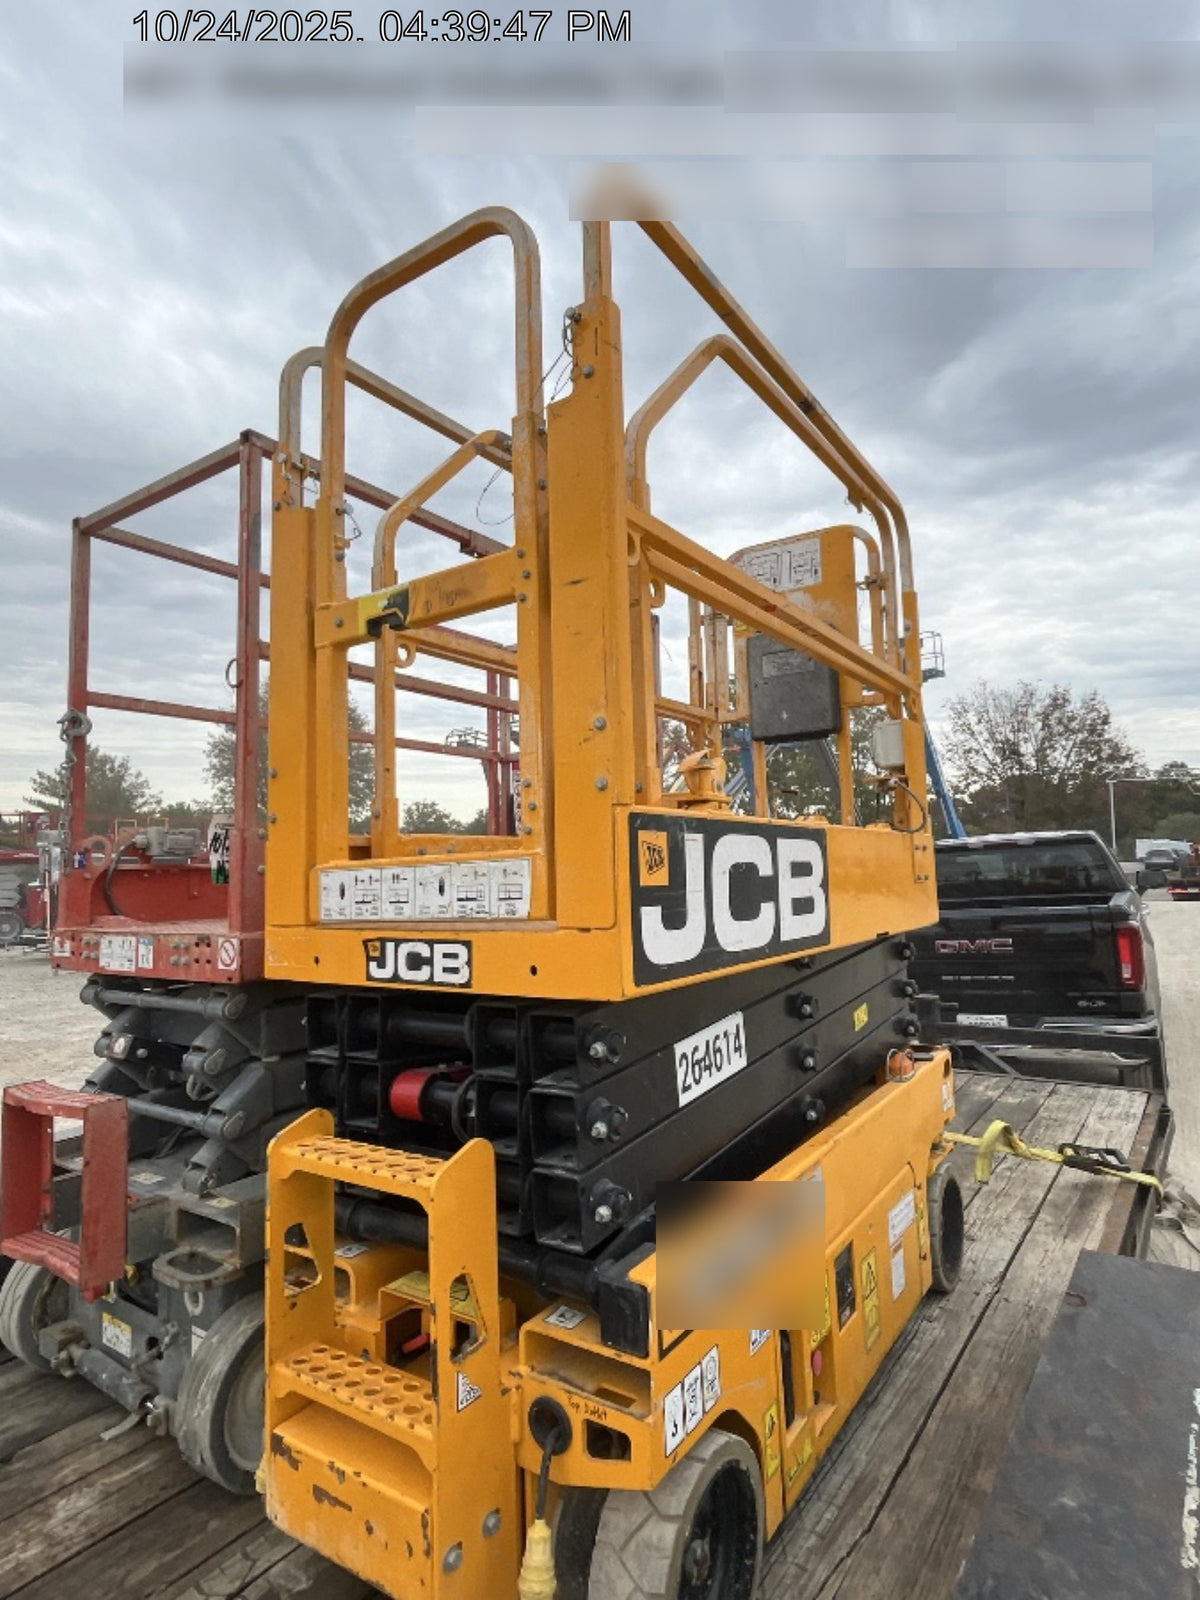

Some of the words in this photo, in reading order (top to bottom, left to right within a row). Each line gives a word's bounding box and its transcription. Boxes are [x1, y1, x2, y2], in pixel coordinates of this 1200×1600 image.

[640, 833, 827, 966] JCB
[368, 941, 470, 984] JCB
[935, 938, 1013, 954] GMC
[679, 1023, 742, 1094] 264614
